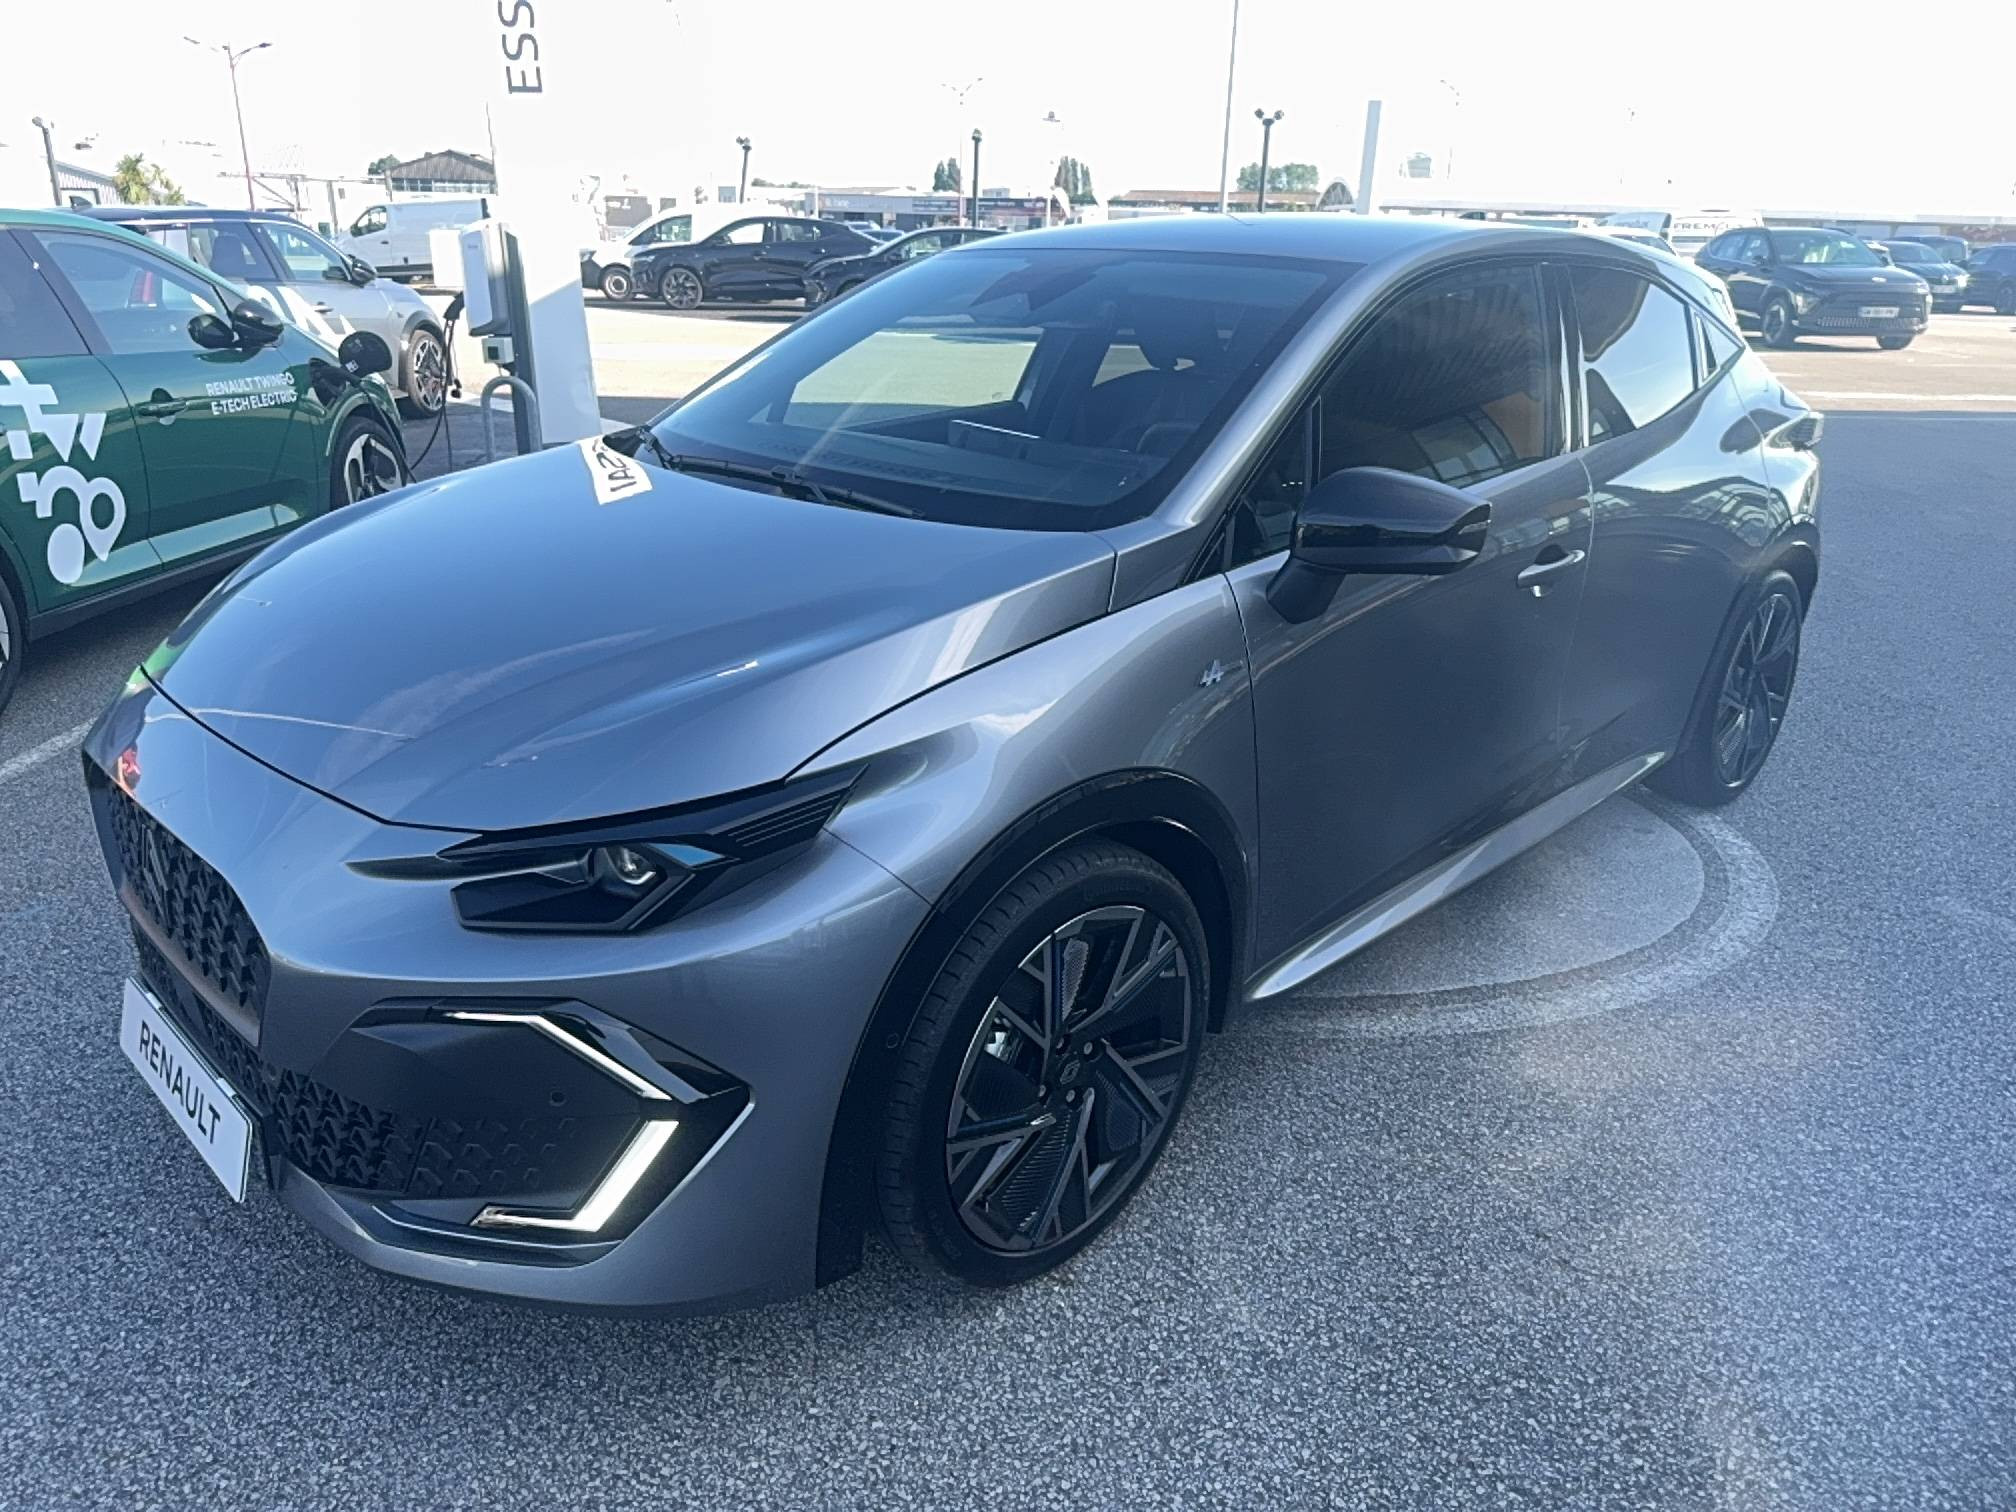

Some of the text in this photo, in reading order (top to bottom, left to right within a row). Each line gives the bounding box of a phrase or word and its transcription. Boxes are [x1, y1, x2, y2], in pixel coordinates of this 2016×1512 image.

[205, 371, 295, 397] RENAULT TWINGO
[211, 389, 298, 416] E-TECH ELECTRIC
[139, 1021, 221, 1144] RENAULT
